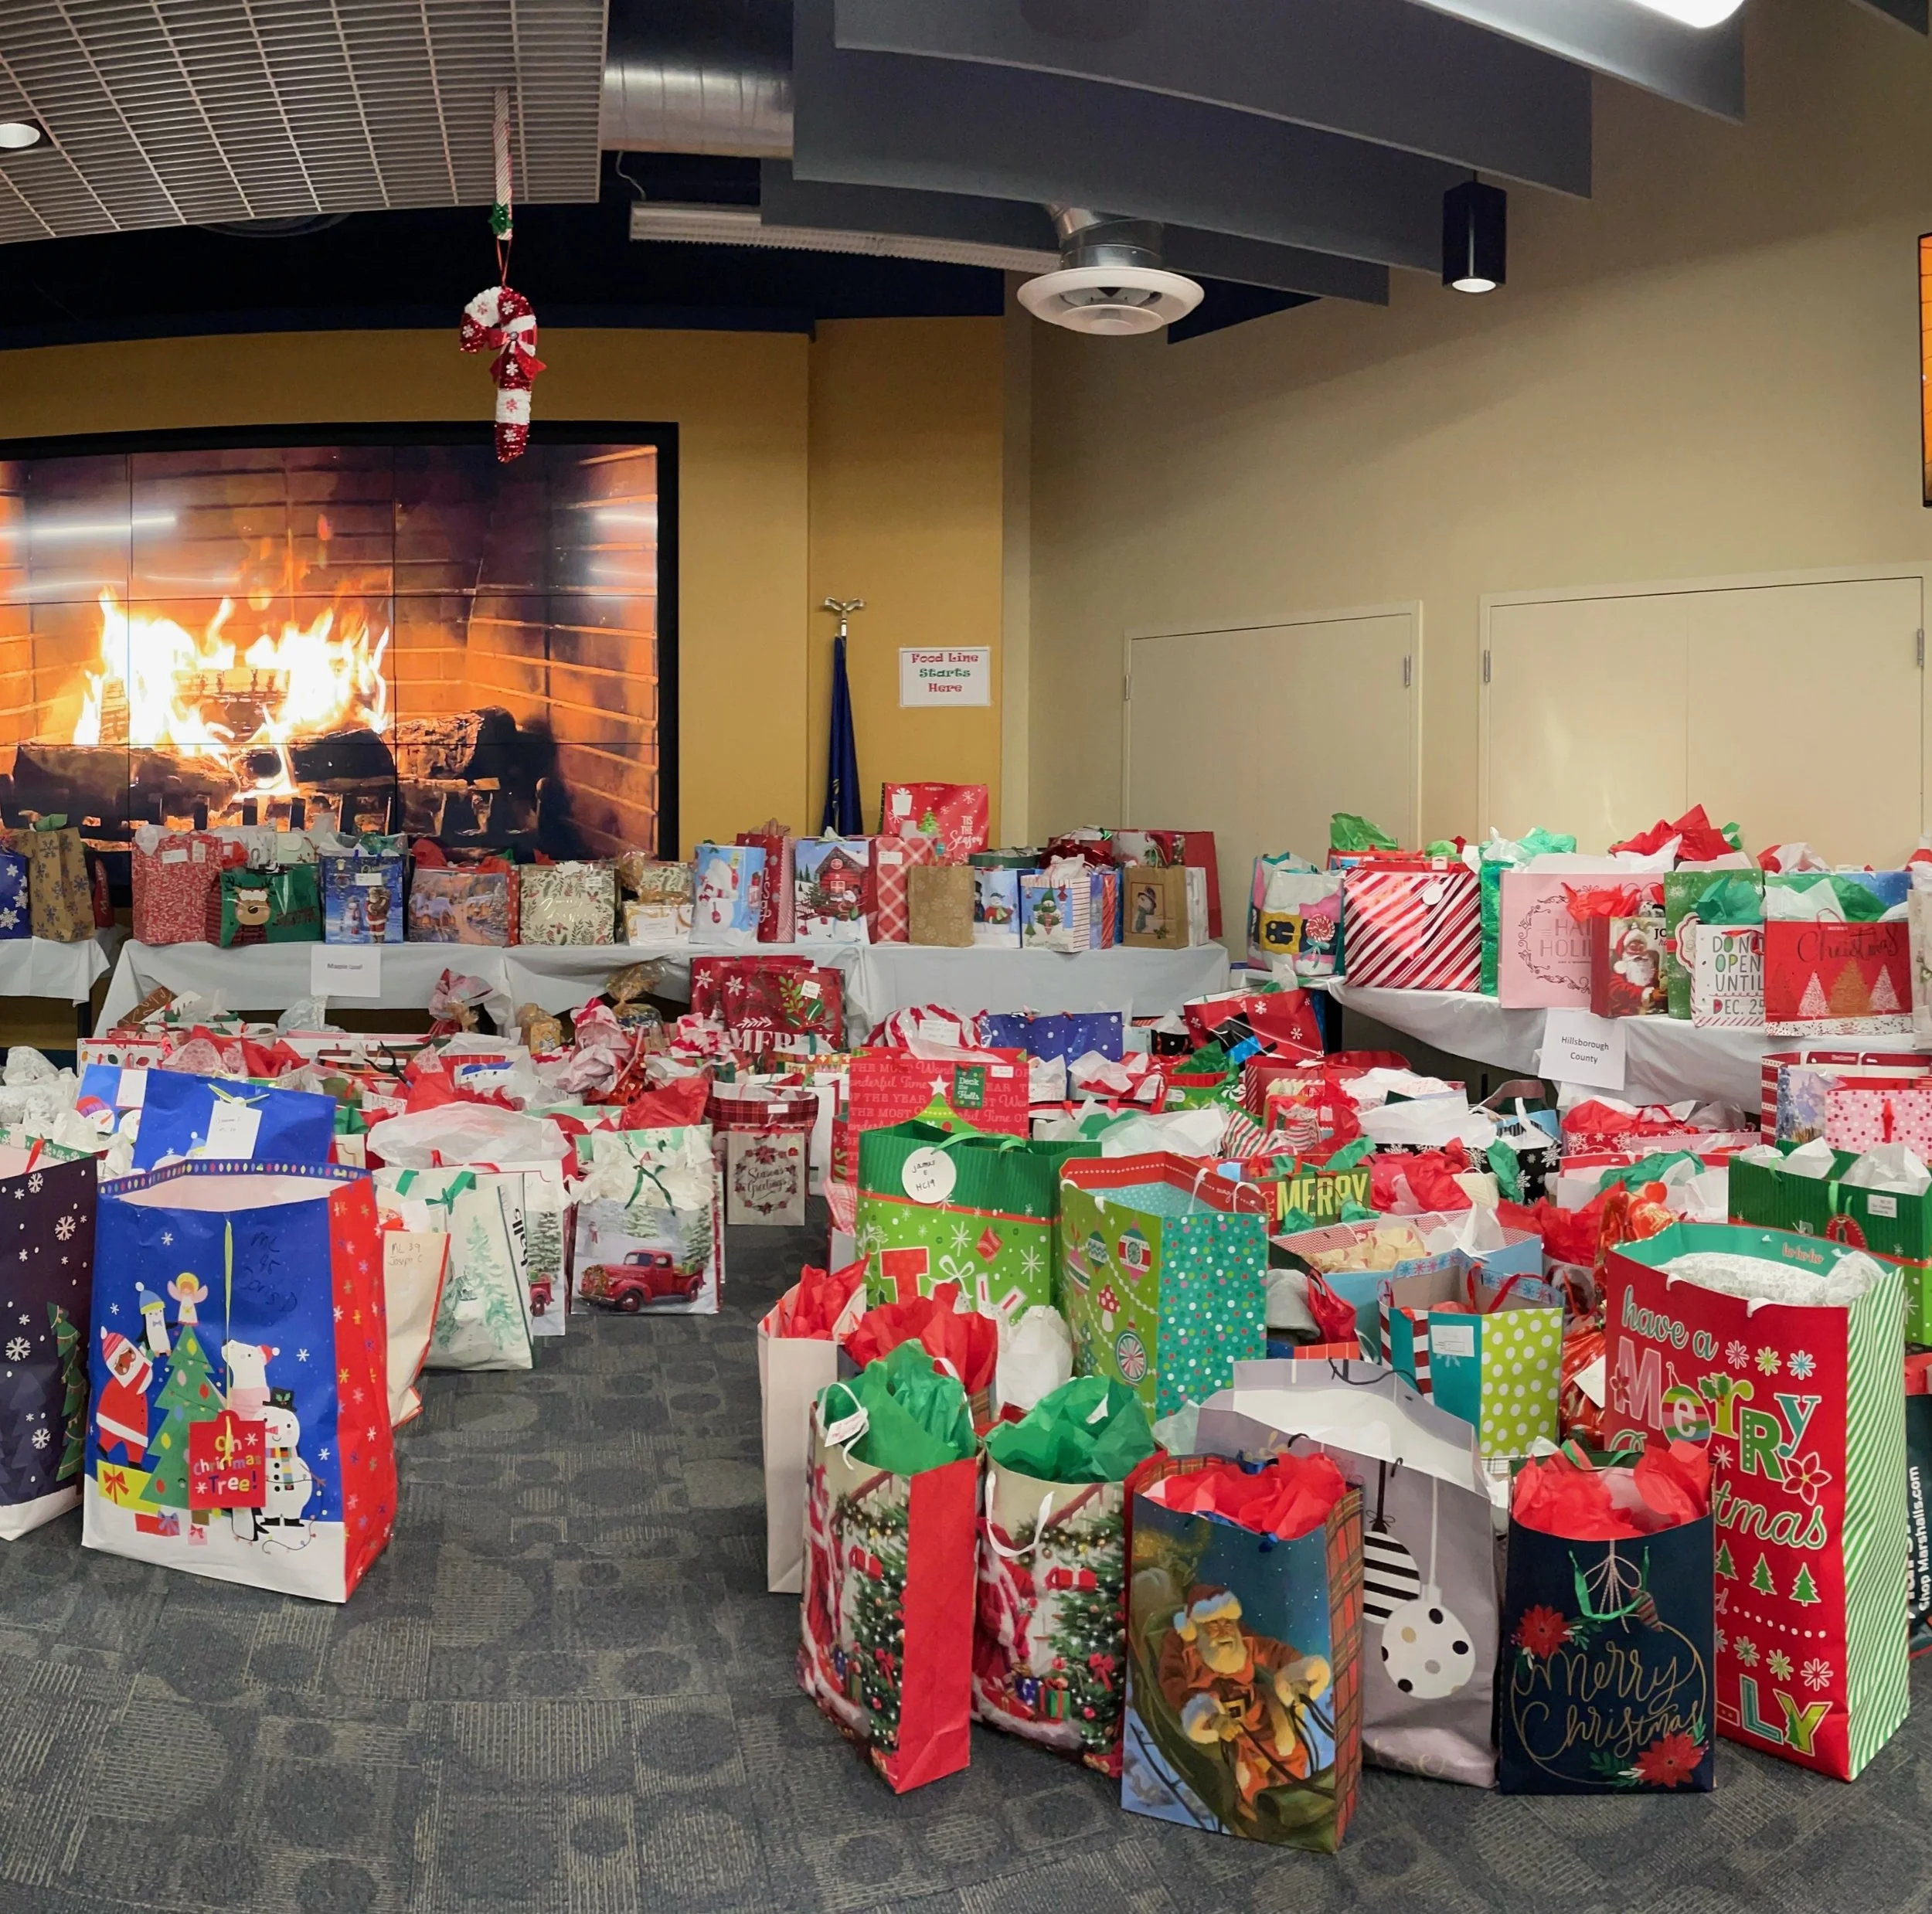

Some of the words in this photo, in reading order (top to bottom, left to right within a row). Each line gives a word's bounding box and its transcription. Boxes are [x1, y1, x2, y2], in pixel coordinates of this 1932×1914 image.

[912, 653, 944, 663] Food
[948, 652, 978, 662] Line
[919, 668, 971, 678] Starts
[928, 683, 962, 692] Here
[961, 825, 974, 835] THE
[1713, 936, 1733, 954] DO
[1798, 923, 1900, 964] Christmas
[1715, 954, 1761, 973] OPEN
[1715, 974, 1764, 992] UNTIL
[1713, 998, 1744, 1015] DEC.
[1561, 1036, 1610, 1052] Hillsborough
[1570, 1052, 1599, 1064] County
[1621, 1284, 1689, 1350] have
[1692, 1330, 1719, 1362] a
[208, 1470, 258, 1496] Tree!
[1918, 1574, 1932, 1612] Shop
